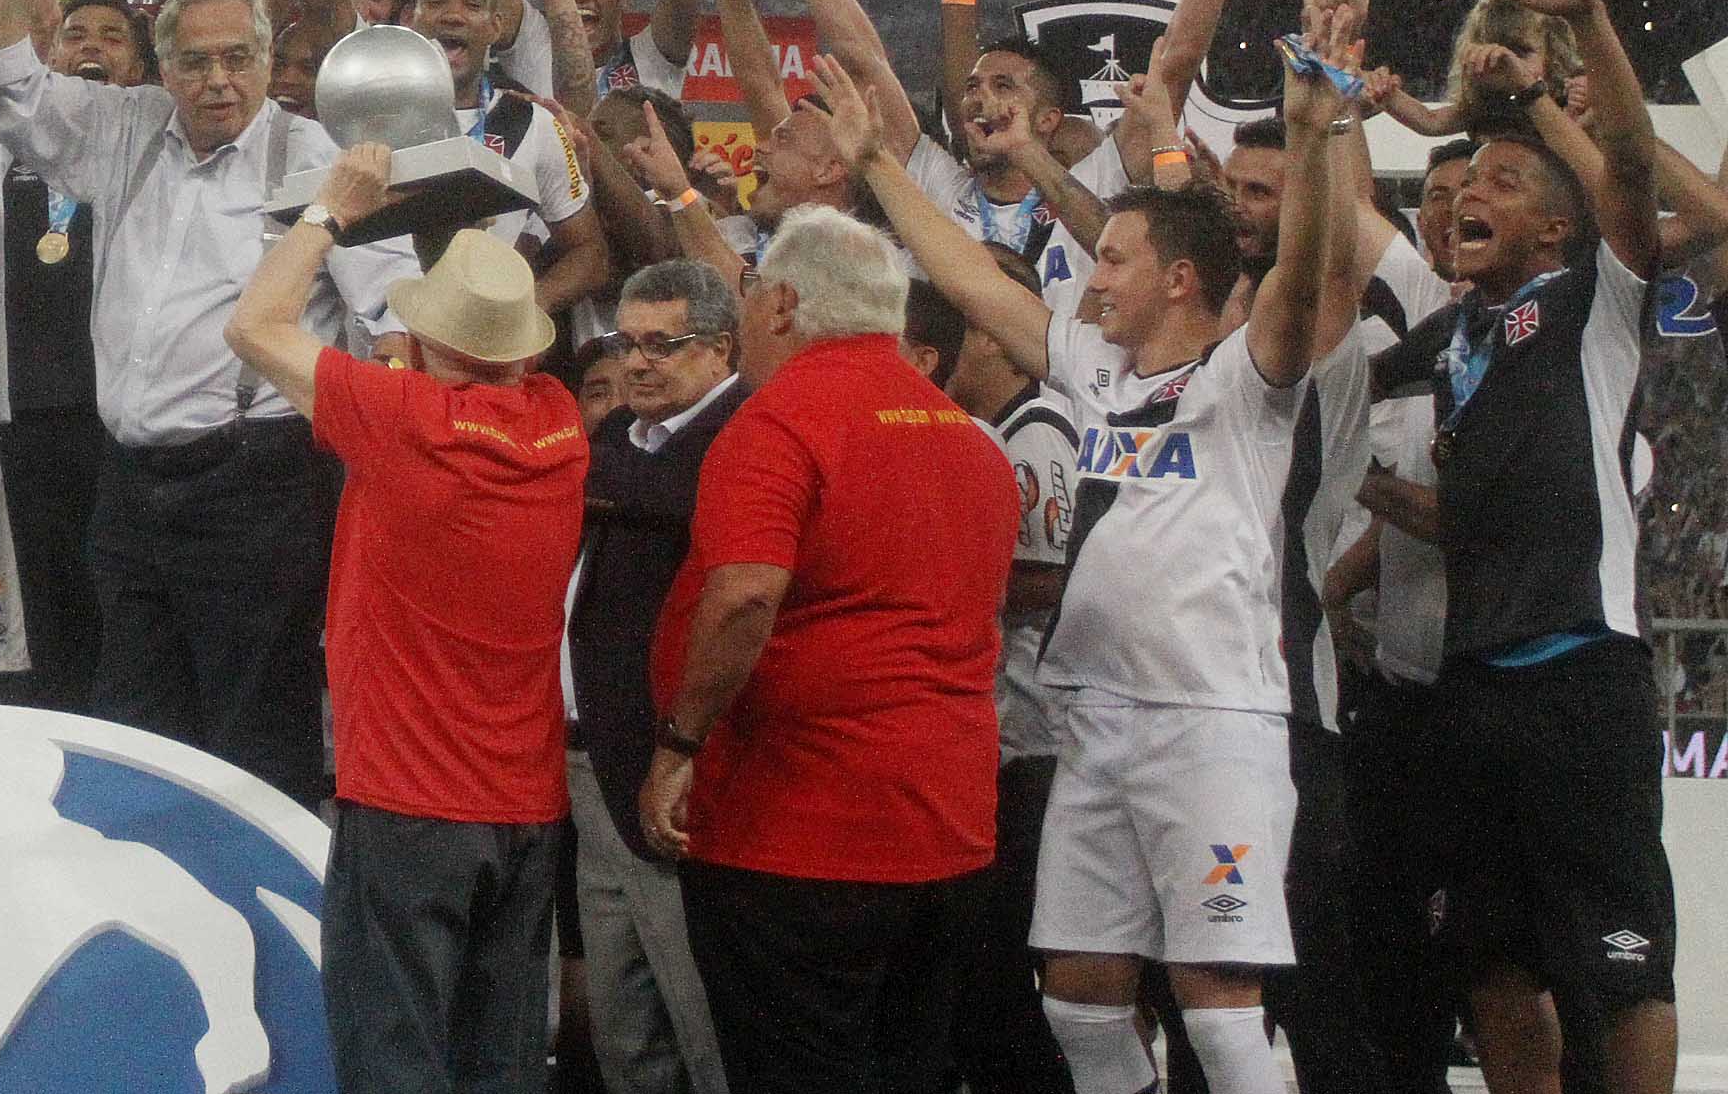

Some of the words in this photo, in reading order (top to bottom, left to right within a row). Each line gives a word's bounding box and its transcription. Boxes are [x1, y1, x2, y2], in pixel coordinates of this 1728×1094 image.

[1076, 427, 1197, 479] AIXA
[1207, 912, 1244, 923] umbro
[1607, 950, 1646, 962] umbro
